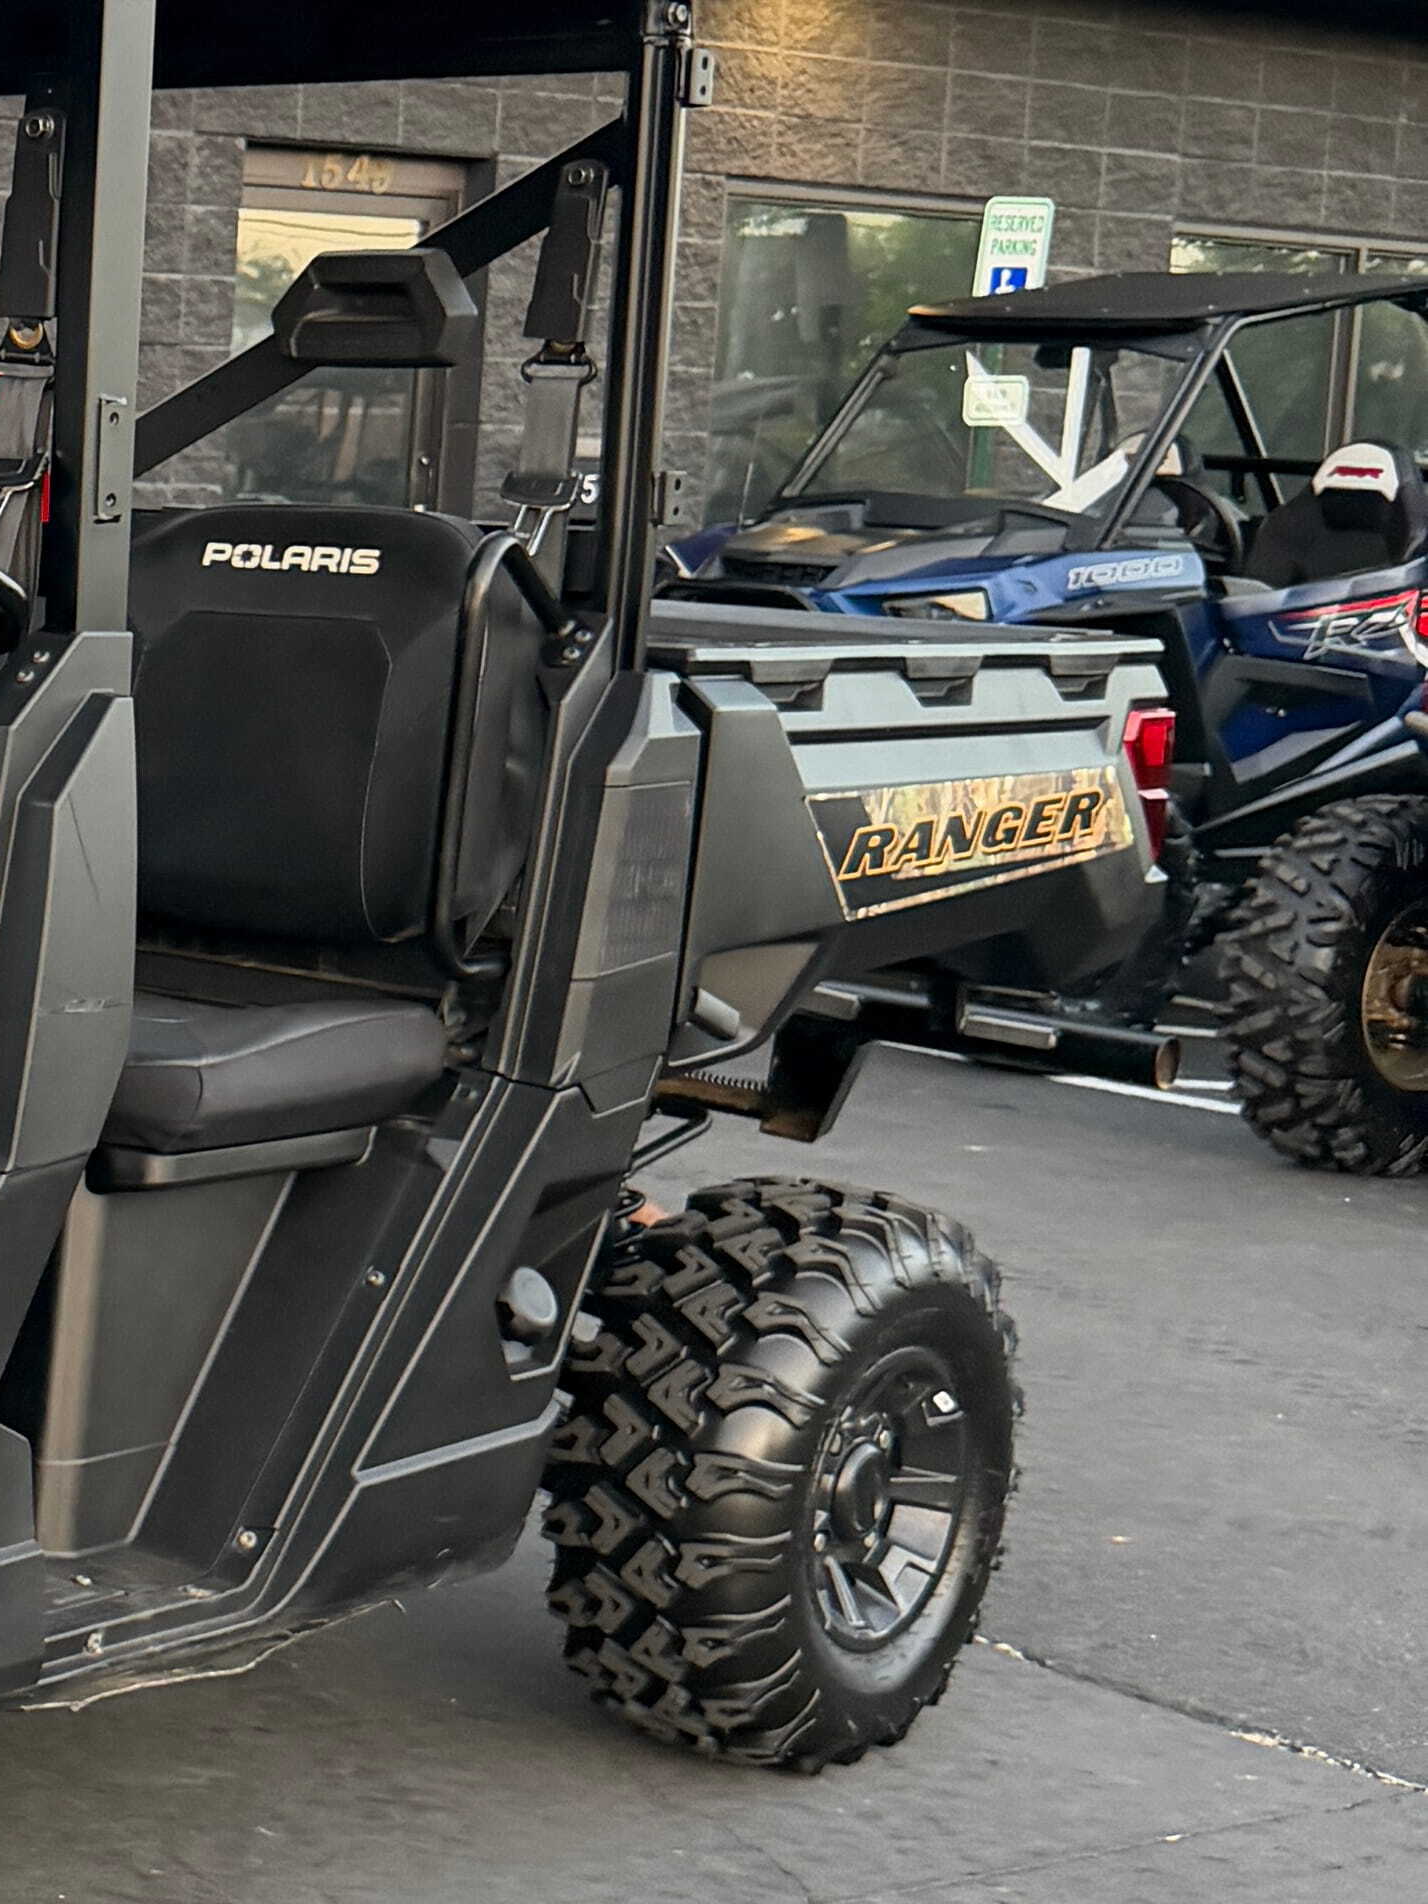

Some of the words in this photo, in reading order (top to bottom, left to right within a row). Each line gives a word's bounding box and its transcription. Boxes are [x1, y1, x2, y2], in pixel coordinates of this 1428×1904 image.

[990, 213, 1045, 233] RESERVED
[990, 238, 1038, 257] PARKING
[201, 542, 381, 575] POLARIS
[1067, 554, 1184, 590] 1000
[838, 786, 1105, 881] RANGER
